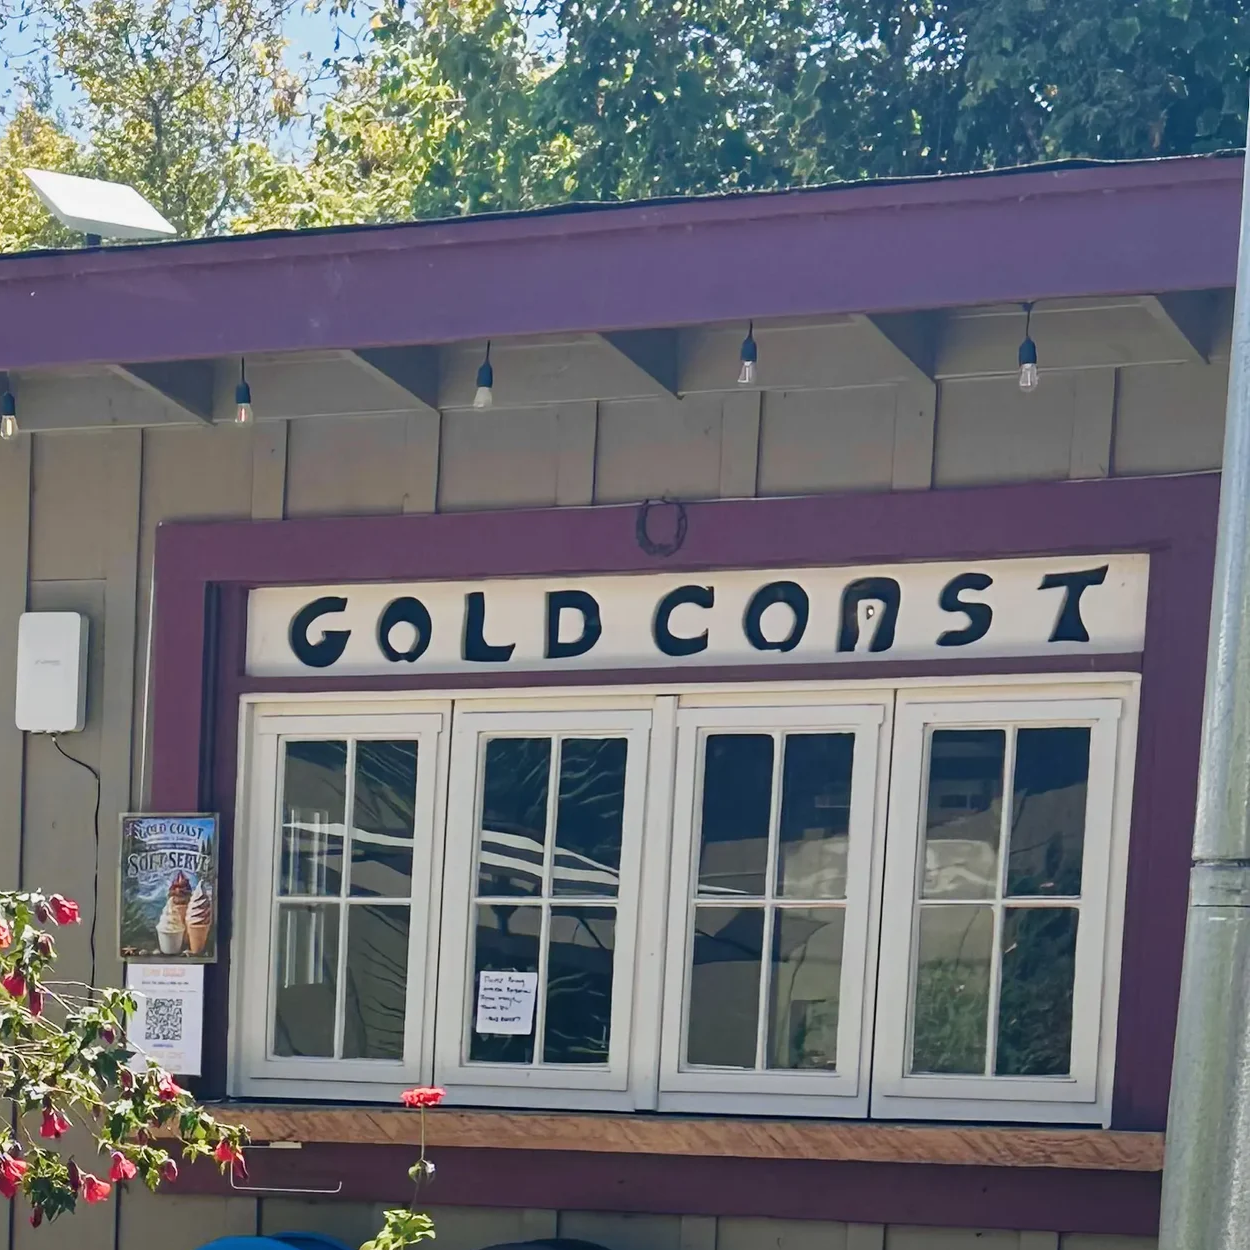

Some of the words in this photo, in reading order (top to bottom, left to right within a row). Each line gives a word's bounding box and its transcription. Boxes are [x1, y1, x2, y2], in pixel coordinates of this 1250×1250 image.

[288, 588, 603, 668] GOLD
[652, 563, 1109, 656] COAST
[138, 823, 166, 839] GOLD
[169, 823, 204, 839] COAST
[127, 853, 168, 876] SOFT
[168, 852, 210, 873] SERVE
